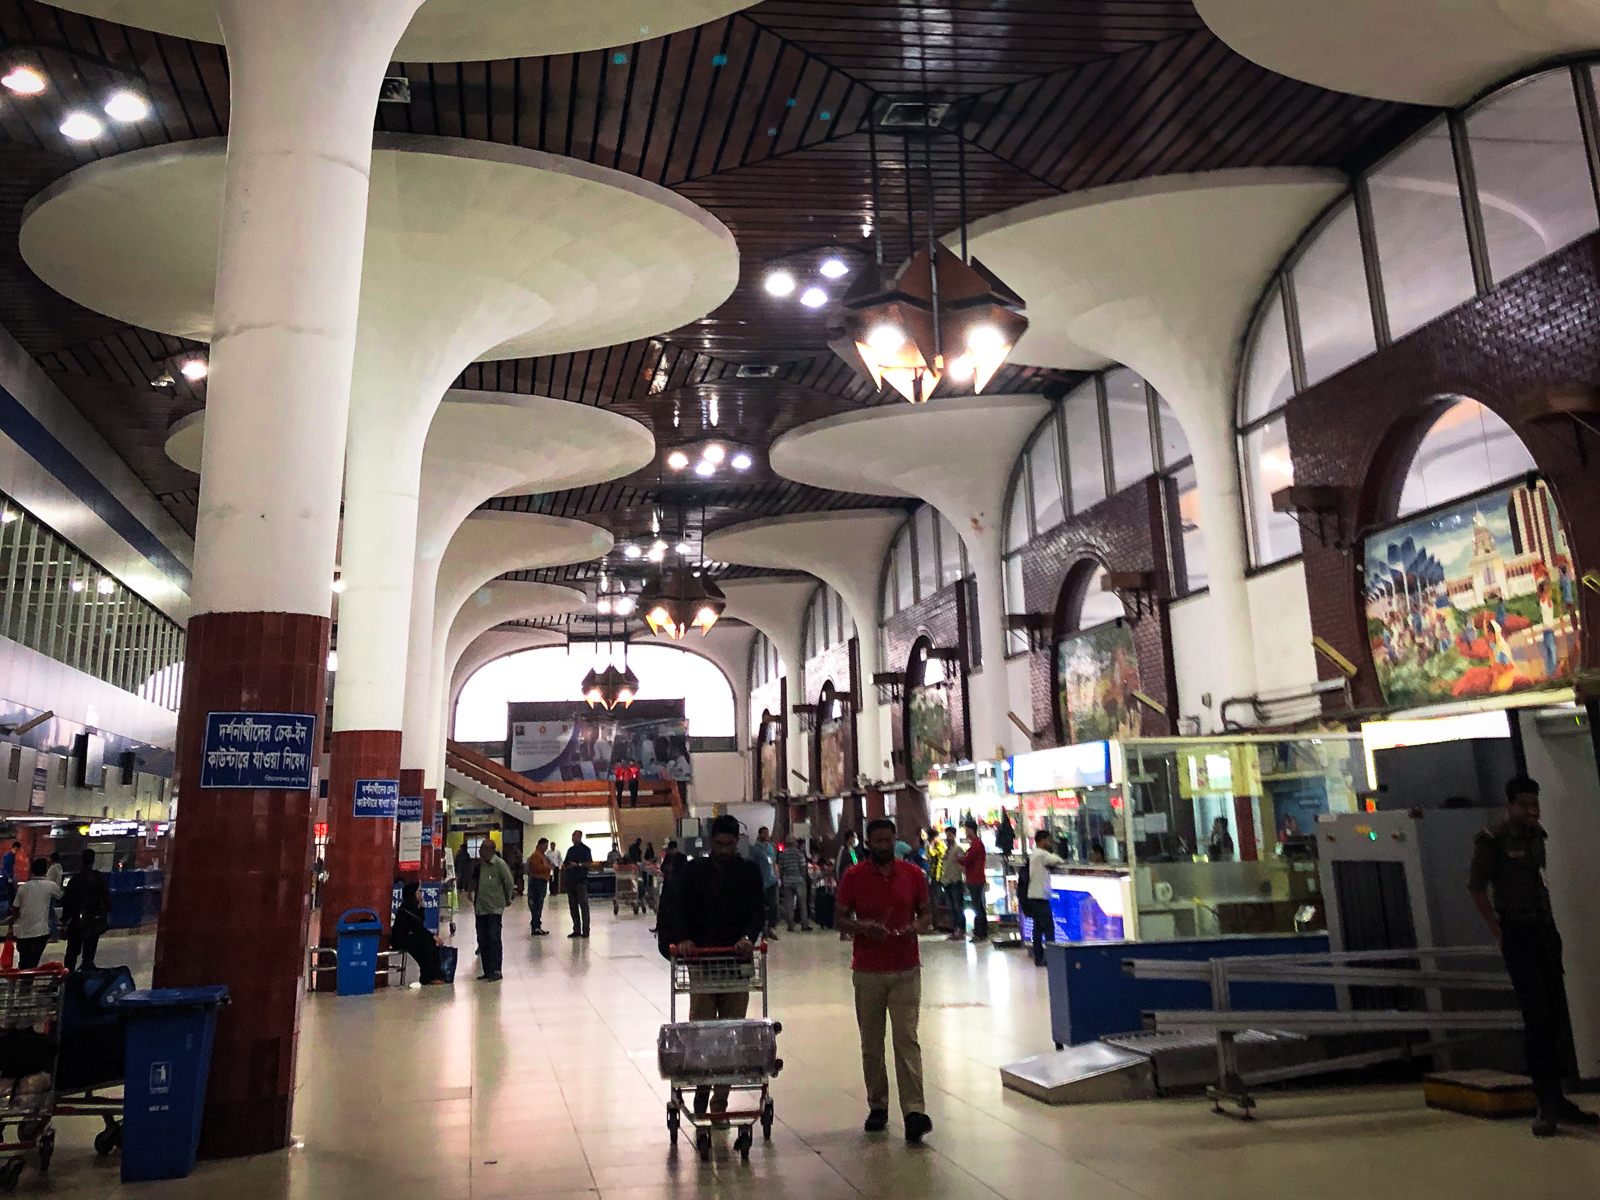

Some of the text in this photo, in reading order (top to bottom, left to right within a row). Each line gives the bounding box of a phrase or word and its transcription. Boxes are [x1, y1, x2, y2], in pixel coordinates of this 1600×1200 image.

[275, 720, 307, 745] চেক-ইন
[208, 745, 250, 769] কাউন্টারে
[252, 750, 281, 770] যাওয়া
